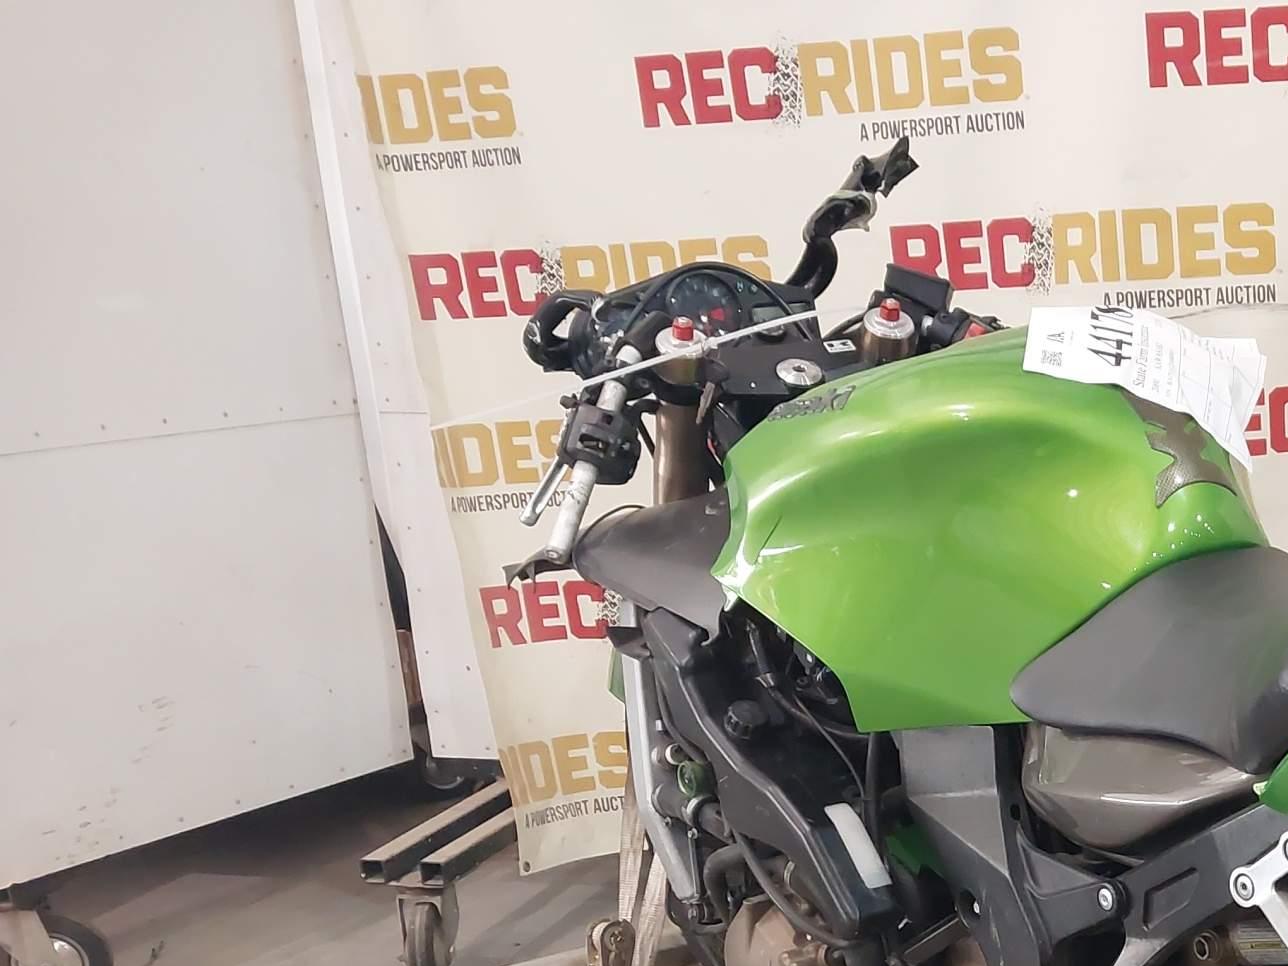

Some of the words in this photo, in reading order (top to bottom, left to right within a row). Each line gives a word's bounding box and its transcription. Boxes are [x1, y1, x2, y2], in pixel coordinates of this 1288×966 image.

[798, 27, 1024, 117] RIDES
[860, 123, 868, 142] A
[872, 115, 961, 141] POWERSPORT
[966, 111, 1025, 133] AUCTION
[382, 150, 468, 172] POWERSPORT
[472, 147, 522, 168] AUCTION
[1052, 203, 1277, 285] RIDES
[1116, 287, 1211, 309] POWERSPORT
[1216, 284, 1276, 305] AUCTION
